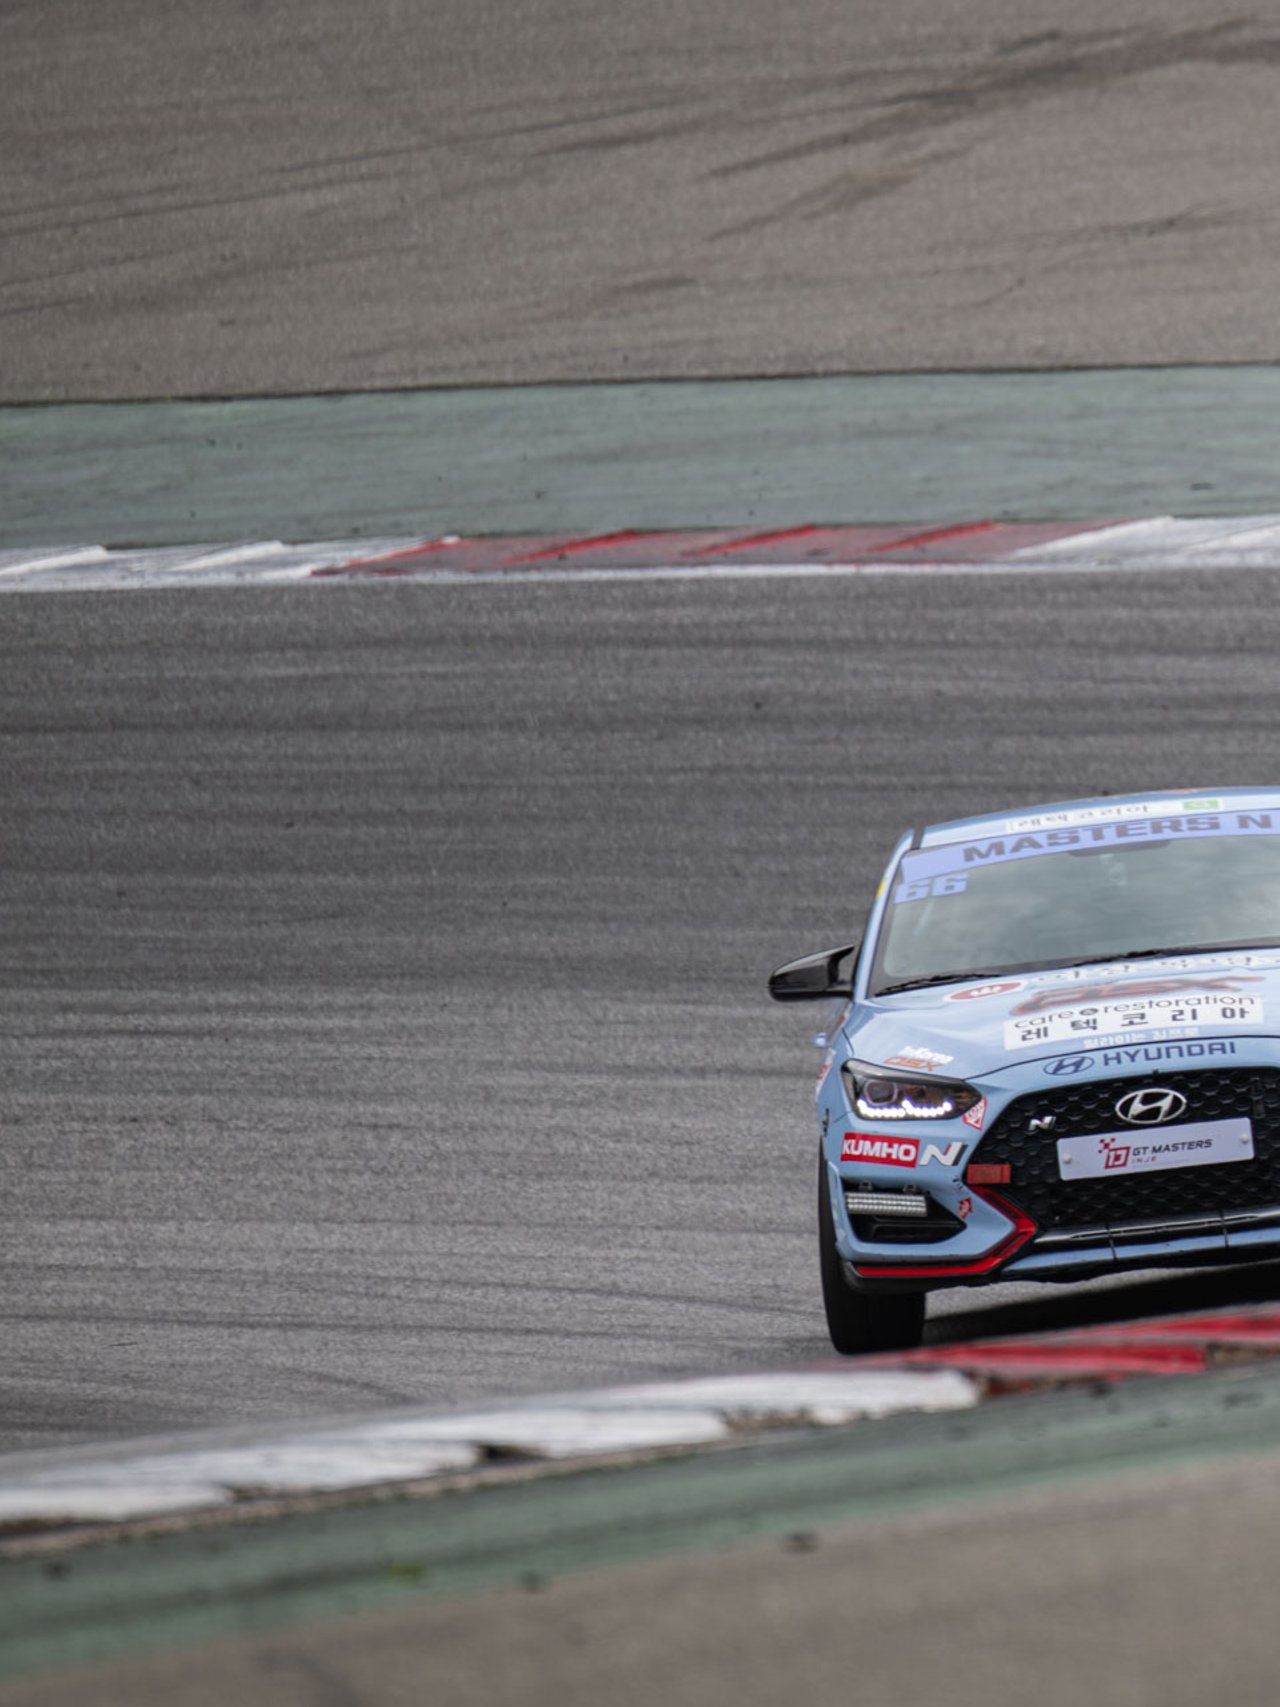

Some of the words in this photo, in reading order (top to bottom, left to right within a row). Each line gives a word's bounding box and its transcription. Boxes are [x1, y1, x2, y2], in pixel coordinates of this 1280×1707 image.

[962, 815, 1221, 862] MASTERS
[1236, 814, 1273, 830] N
[894, 872, 969, 905] 66
[1014, 1008, 1074, 1029] care
[1103, 994, 1255, 1014] restoration
[1103, 1042, 1236, 1066] HYUNDAI
[843, 1138, 916, 1162] KUMHO
[1132, 1146, 1150, 1157] GT
[1151, 1139, 1213, 1154] MASTERS
